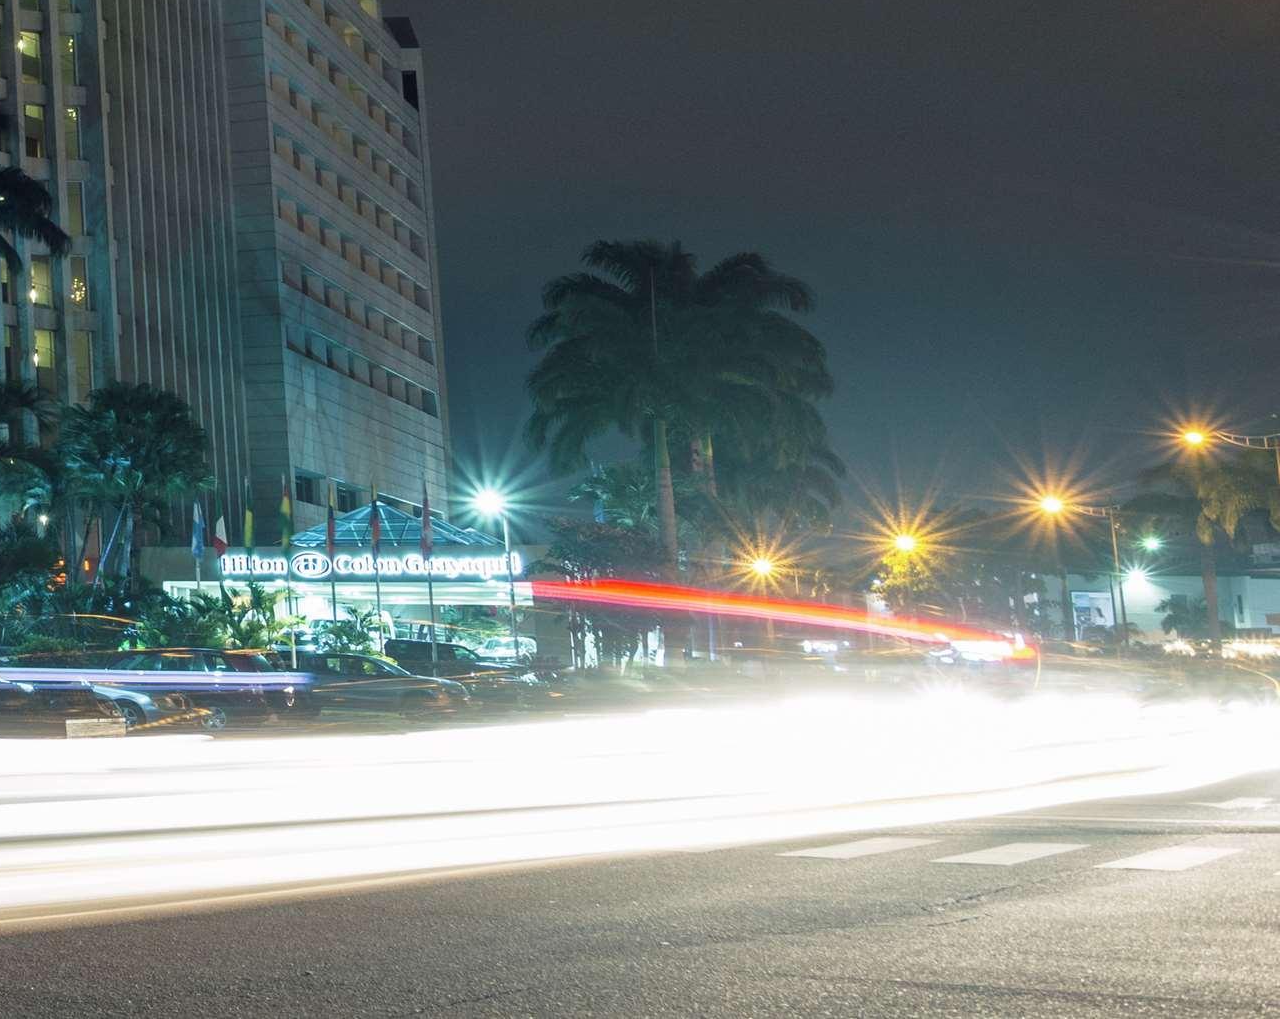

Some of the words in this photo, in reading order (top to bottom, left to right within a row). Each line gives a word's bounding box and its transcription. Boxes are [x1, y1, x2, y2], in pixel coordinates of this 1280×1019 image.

[221, 555, 286, 573] Hilton
[335, 554, 400, 573] Colon
[404, 552, 519, 578] Guayaquil
